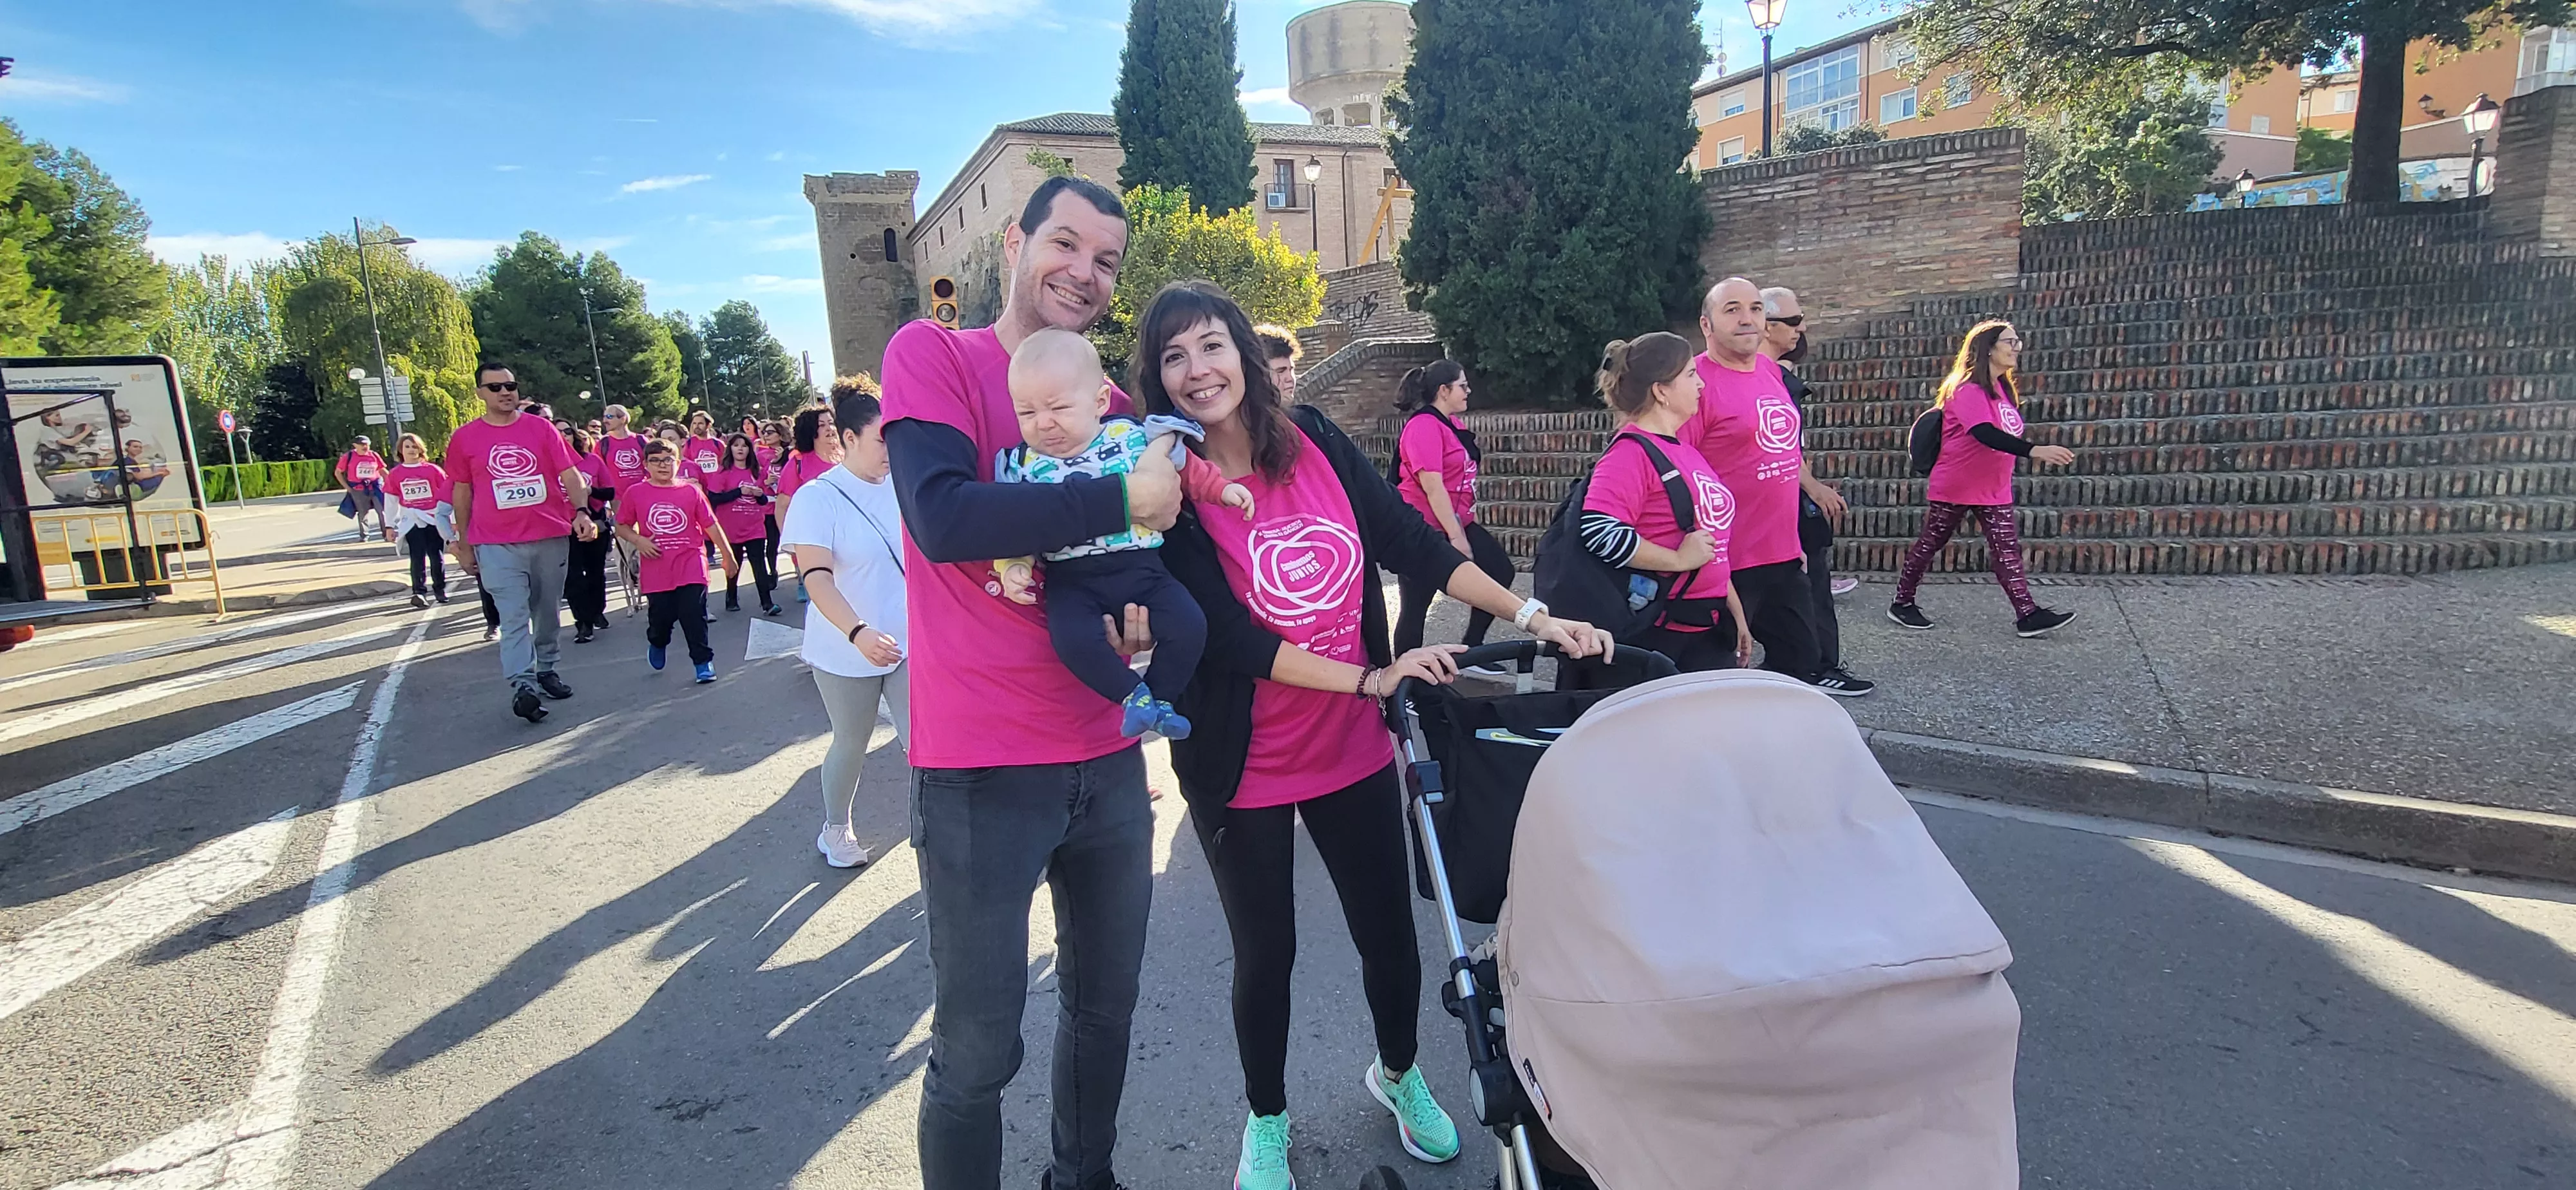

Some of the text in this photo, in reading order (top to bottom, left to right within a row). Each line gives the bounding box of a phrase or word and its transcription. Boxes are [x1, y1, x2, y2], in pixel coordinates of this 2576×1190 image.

[404, 486, 428, 495] 2873
[506, 486, 536, 500] 290
[1287, 559, 1321, 582] JUNTOS
